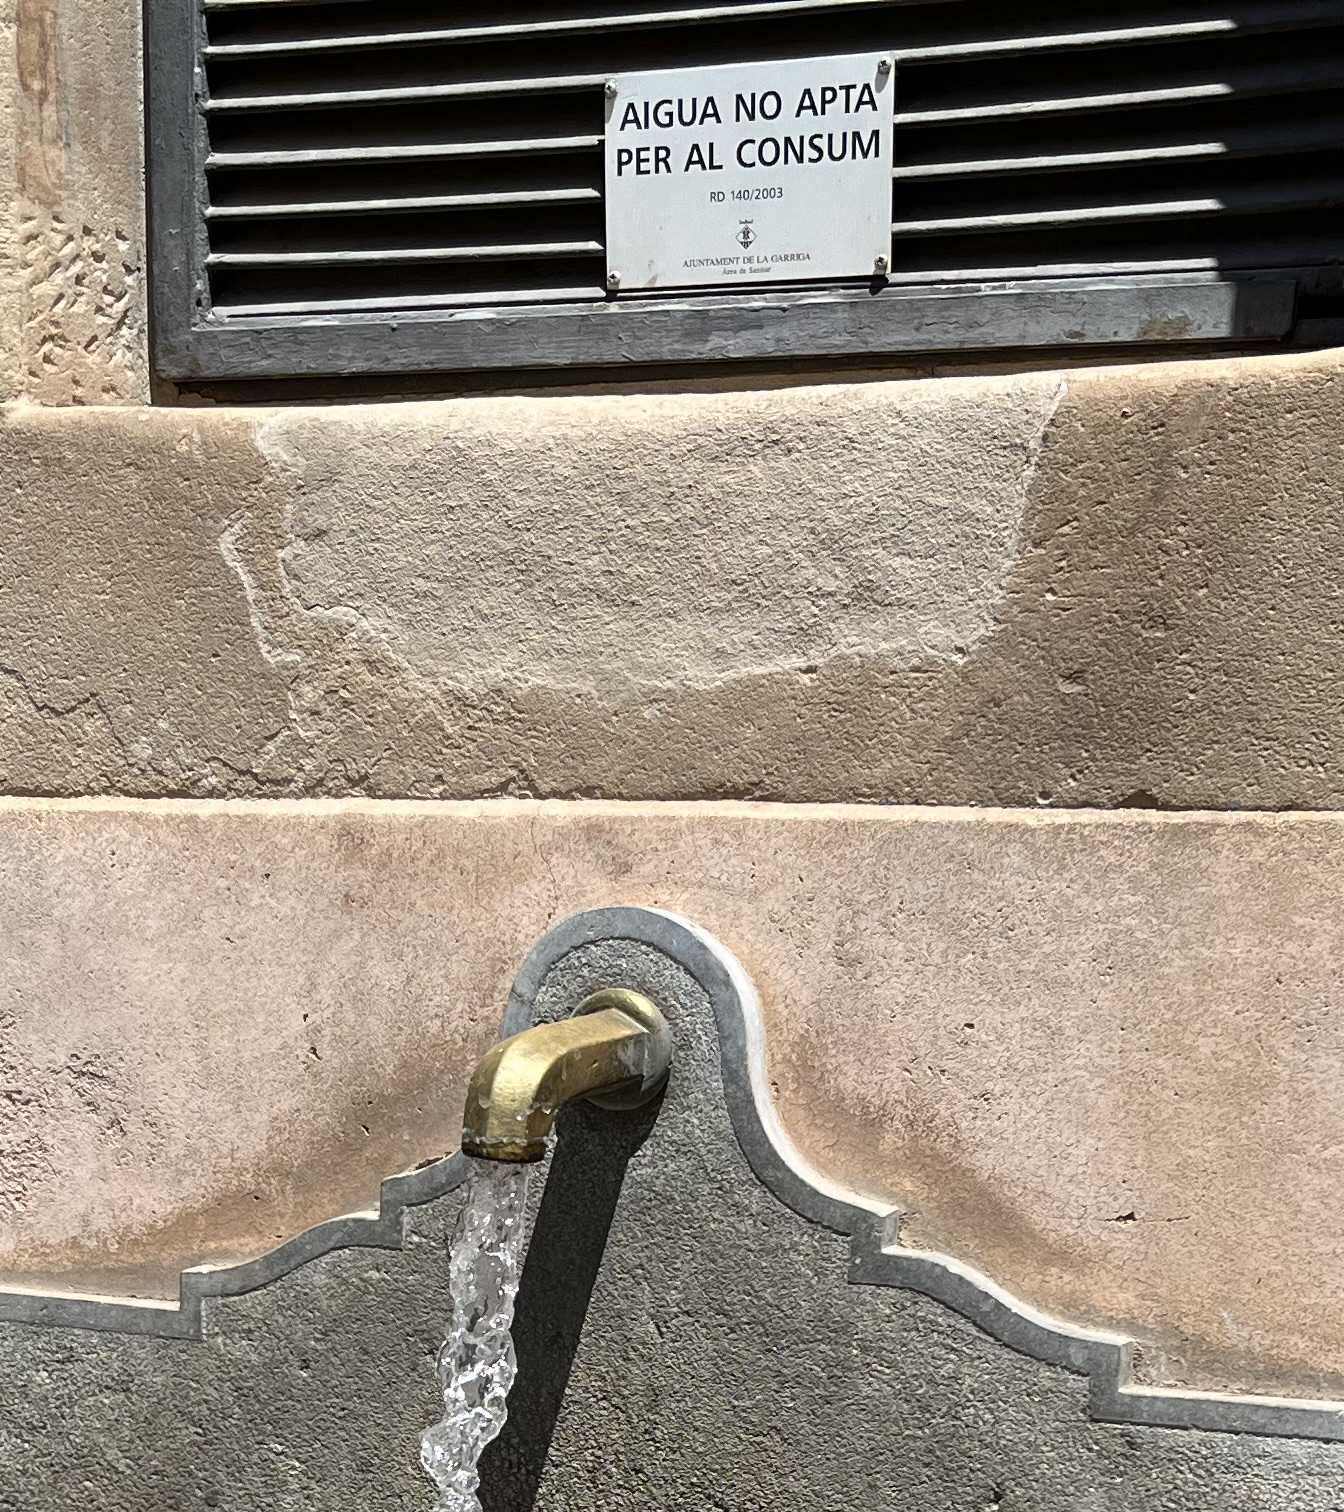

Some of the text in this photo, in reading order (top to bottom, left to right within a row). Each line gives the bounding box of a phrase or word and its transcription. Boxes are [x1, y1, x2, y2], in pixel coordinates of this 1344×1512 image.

[619, 82, 878, 131] AIGUA NO APTA
[616, 129, 880, 177] PER AL CONSUM
[709, 187, 784, 203] RD 140/2003
[682, 252, 811, 268] AJUNTAMENT DE LA GARRIGA
